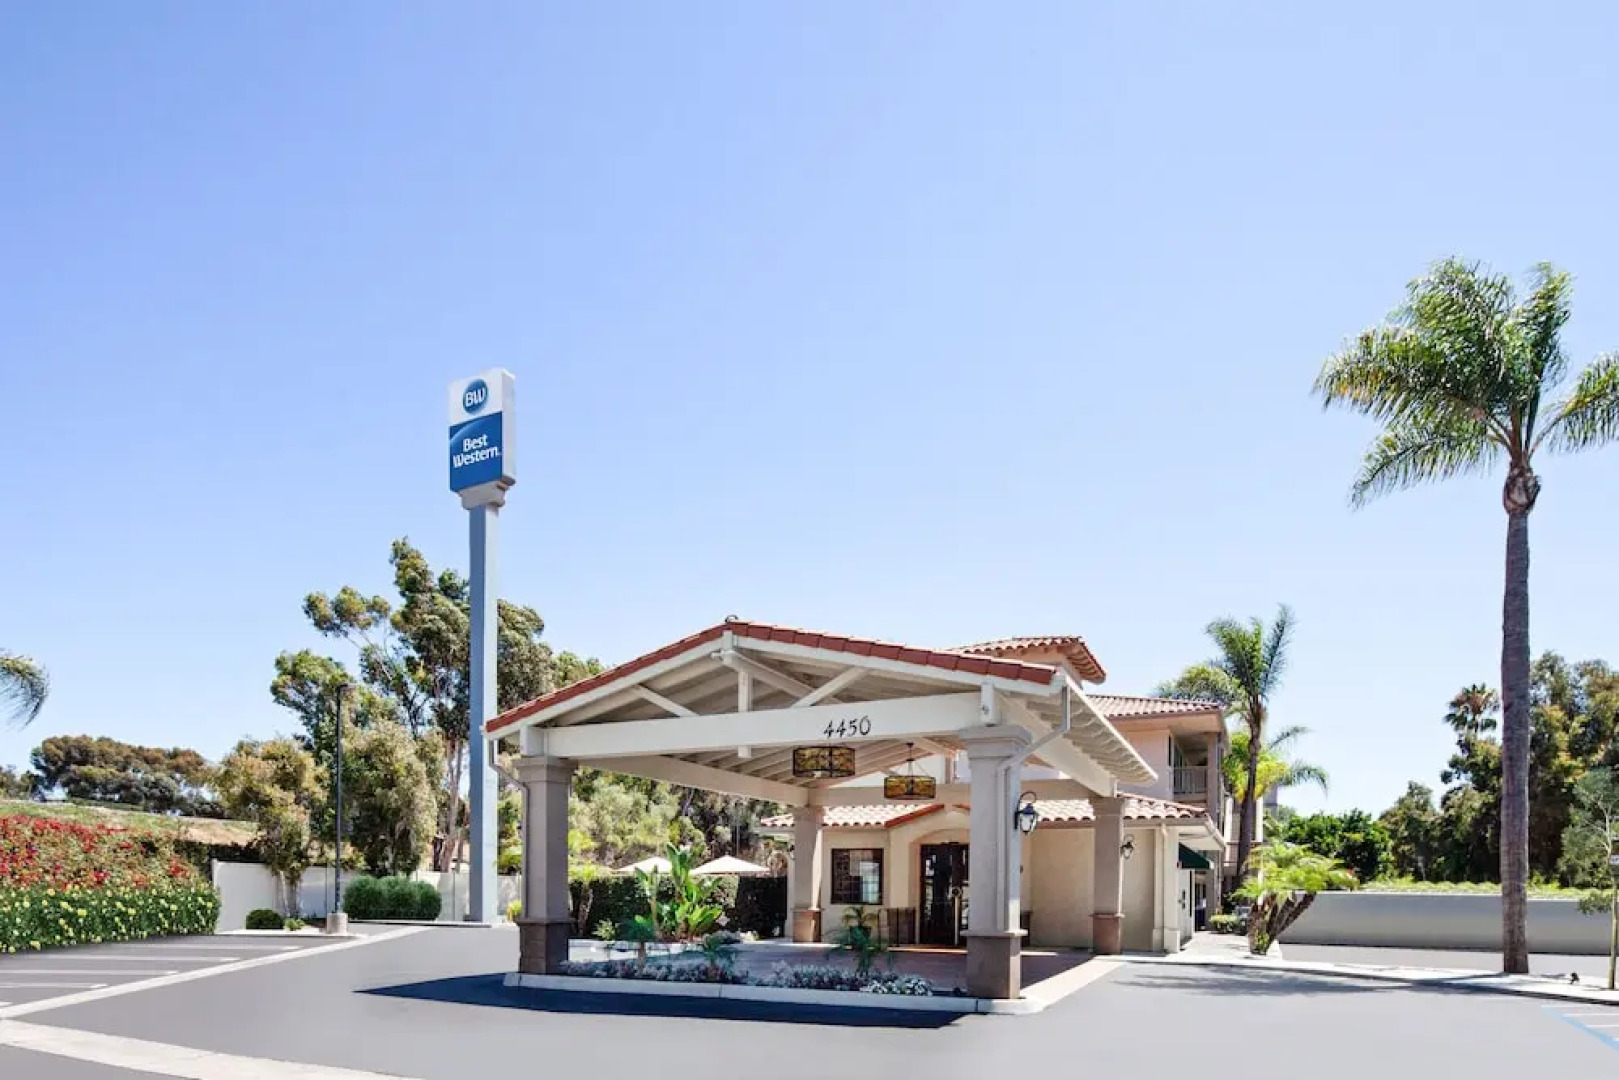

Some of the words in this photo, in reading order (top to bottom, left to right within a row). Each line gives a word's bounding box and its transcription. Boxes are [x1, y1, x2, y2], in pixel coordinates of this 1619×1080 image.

[465, 387, 485, 407] BW
[463, 434, 488, 452] Best
[453, 447, 498, 468] Western
[823, 716, 871, 739] 4450
